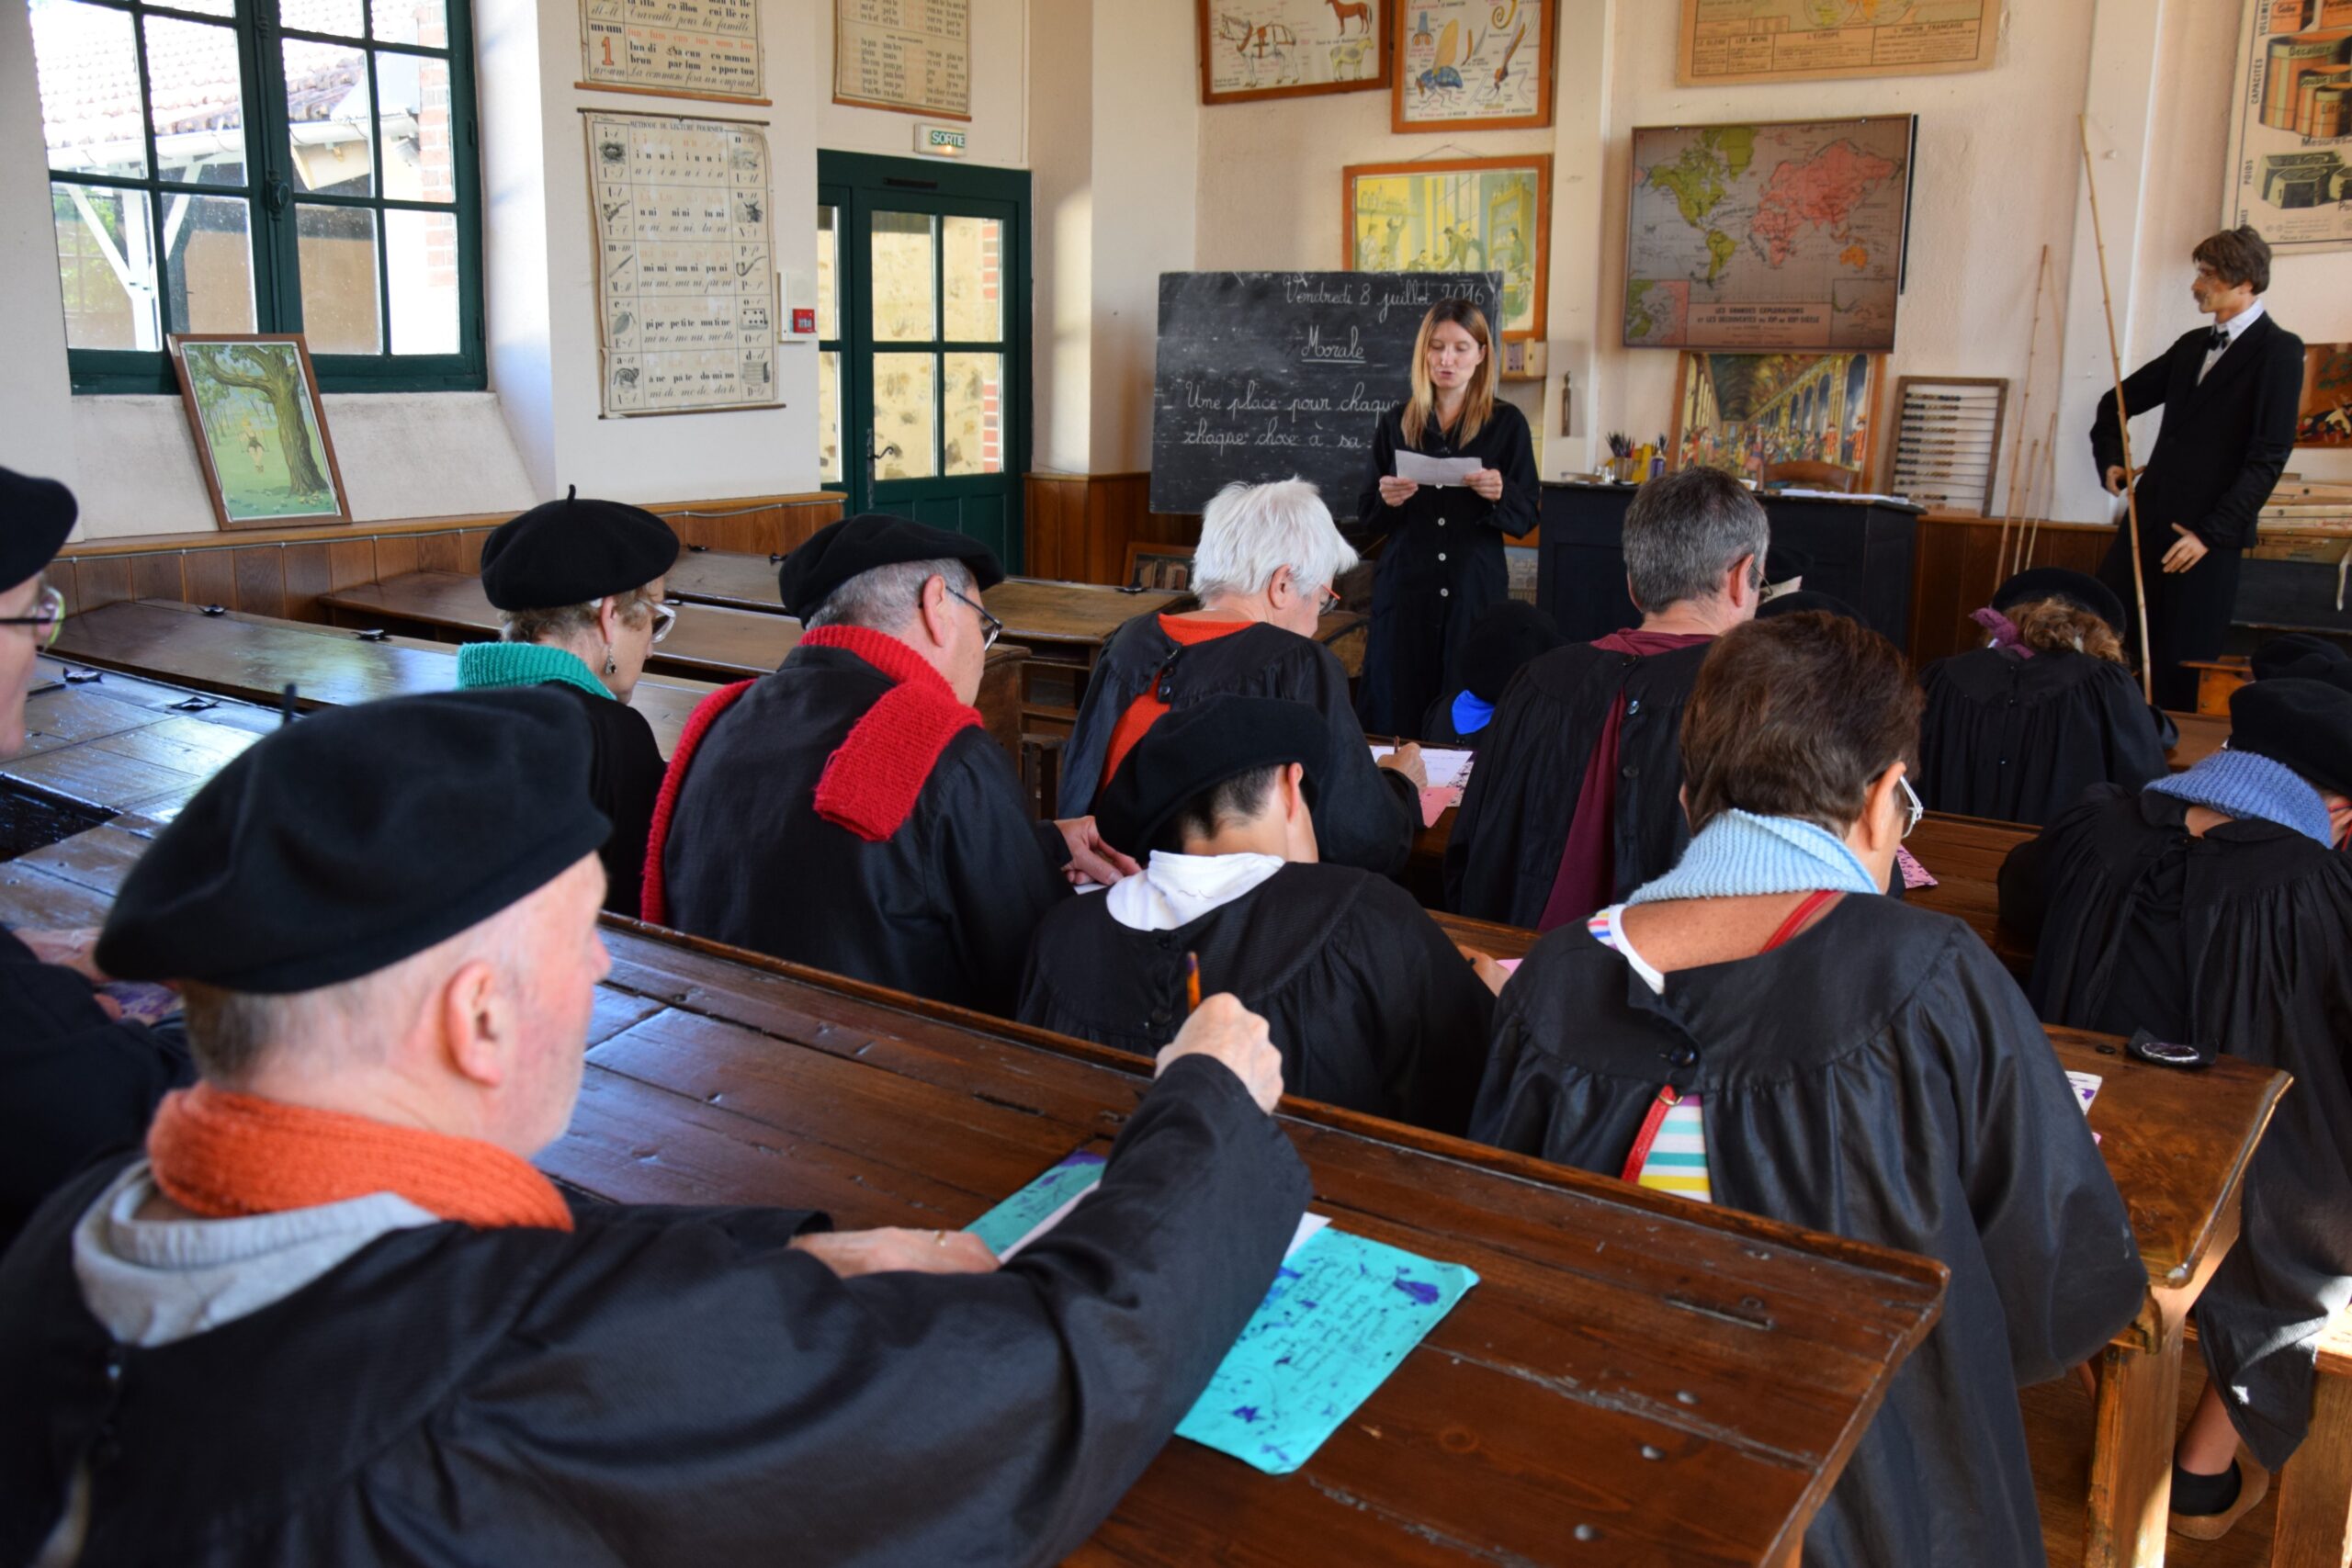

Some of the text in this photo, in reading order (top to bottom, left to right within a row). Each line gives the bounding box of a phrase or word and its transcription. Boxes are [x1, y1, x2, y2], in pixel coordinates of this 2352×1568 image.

[601, 36, 614, 66] 1
[629, 40, 645, 52] lun
[648, 43, 656, 53] di
[630, 54, 651, 65] brun
[668, 60, 683, 70] par
[932, 131, 966, 147] SORTIE
[2244, 159, 2254, 186] POIDS
[1286, 279, 1352, 305] Vendredi
[1359, 283, 1371, 305] 8
[1376, 278, 1433, 321] juillet
[1301, 324, 1365, 359] Morale
[1185, 381, 1222, 411] Une
[1226, 379, 1279, 422] place
[1286, 395, 1332, 423] pour
[1182, 416, 1362, 457] chaque chose à sa
